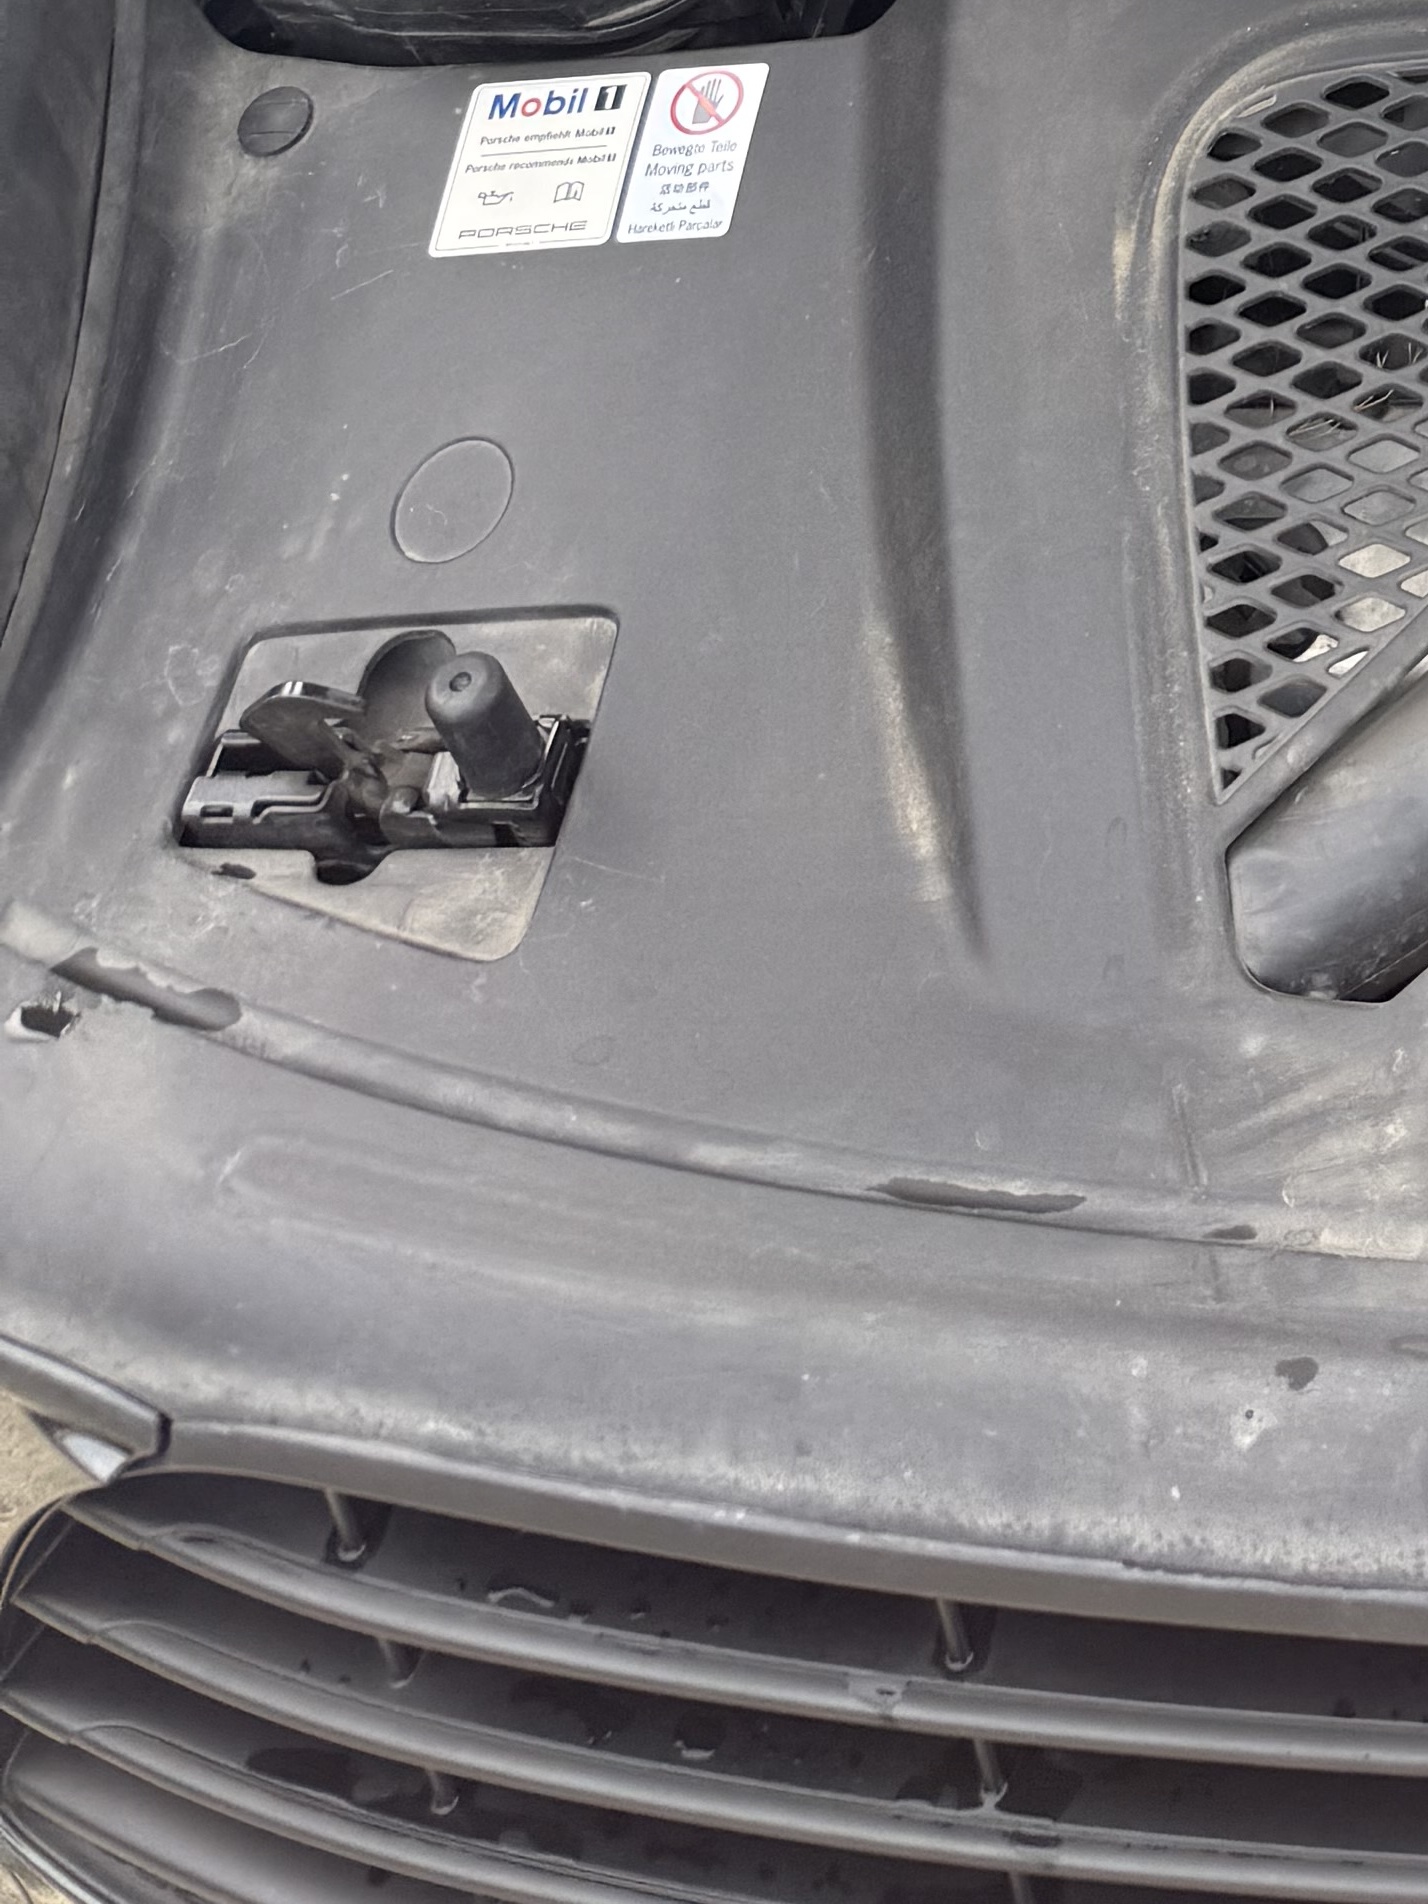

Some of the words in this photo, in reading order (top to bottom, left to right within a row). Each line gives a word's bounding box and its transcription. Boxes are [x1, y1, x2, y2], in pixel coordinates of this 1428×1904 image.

[488, 88, 589, 120] Mobil
[597, 84, 623, 111] 1
[480, 134, 520, 146] Porsche
[524, 131, 571, 144] empfiehlt
[652, 143, 705, 157] Bewegte
[711, 139, 738, 153] Teile
[465, 163, 506, 174] Porsche
[509, 158, 574, 170] recommends
[644, 162, 694, 177] Moving
[697, 159, 734, 176] parts
[458, 220, 588, 239] PORSCHE
